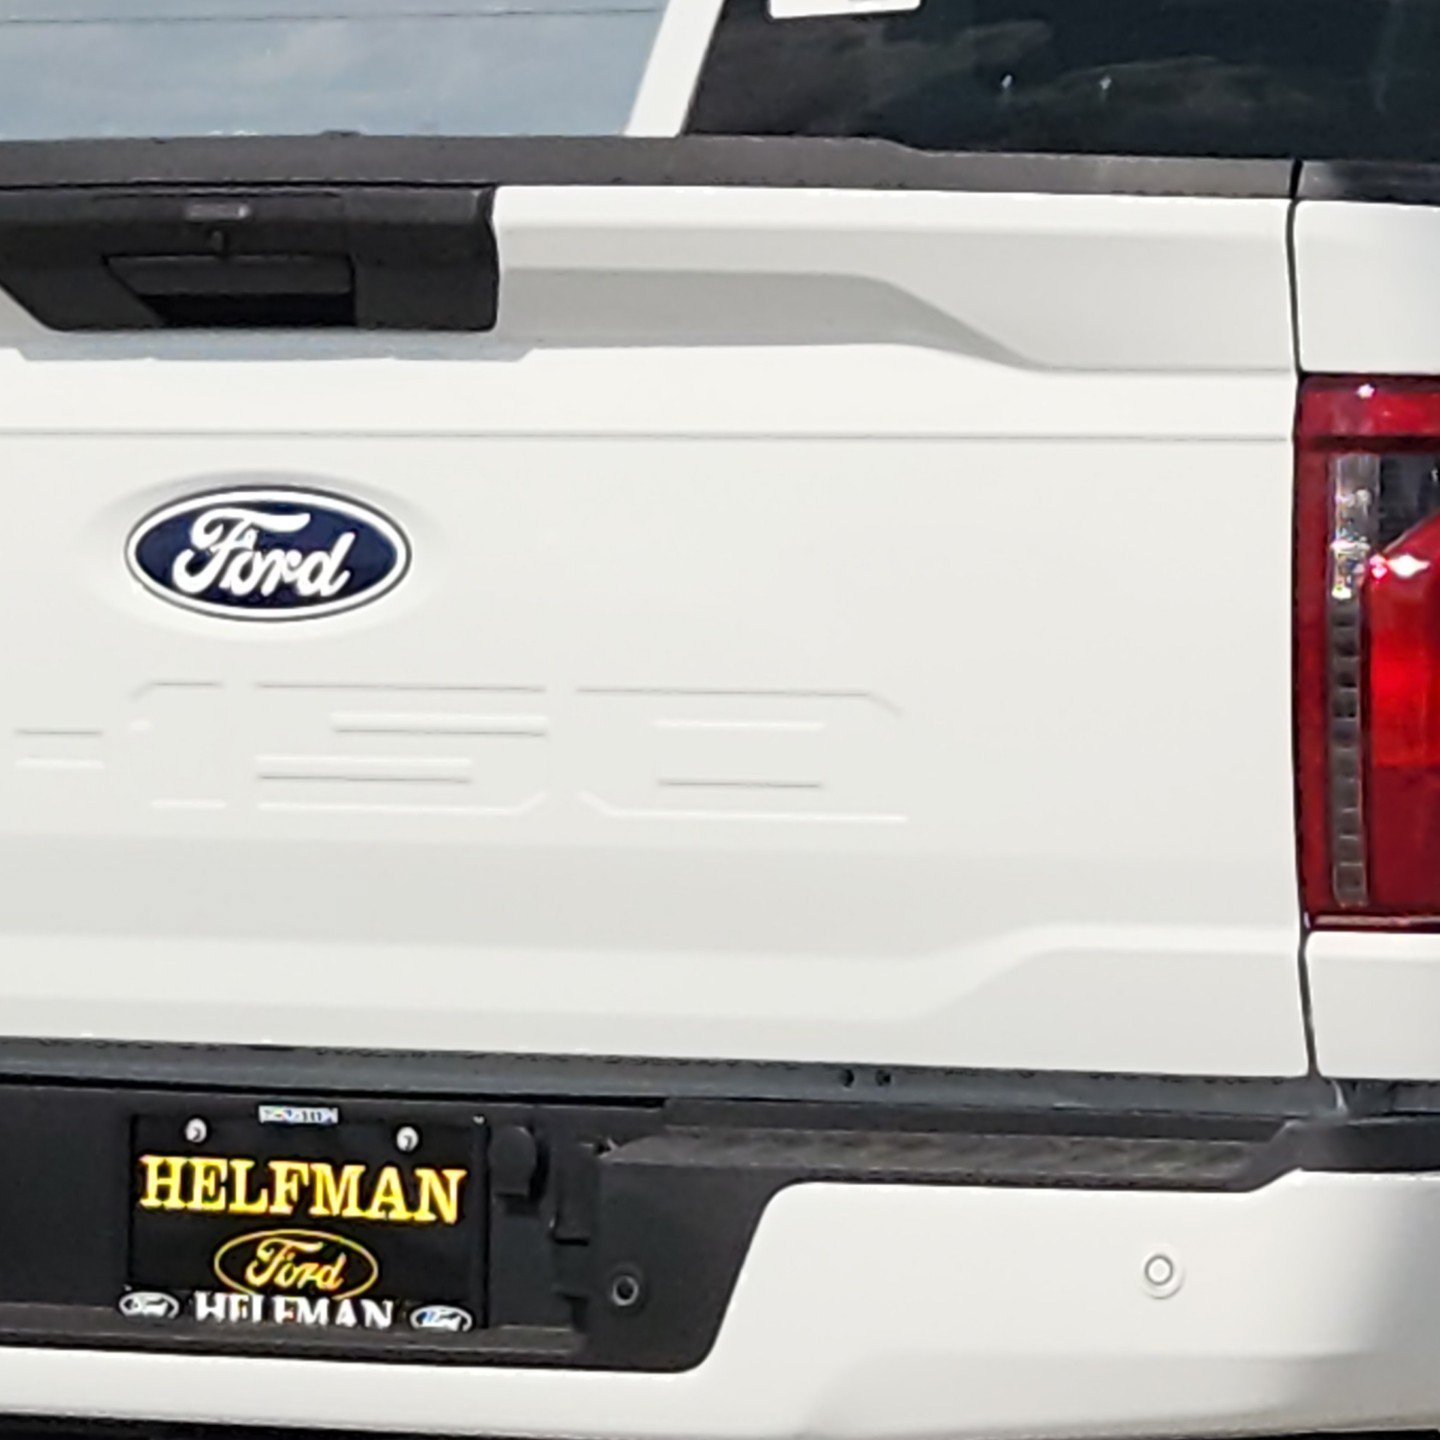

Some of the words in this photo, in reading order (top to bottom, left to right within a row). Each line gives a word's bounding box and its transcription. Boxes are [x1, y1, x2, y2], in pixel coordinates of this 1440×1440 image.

[172, 507, 356, 597] Ford
[138, 1153, 468, 1225] HELFMAN
[244, 1236, 347, 1290] Ford
[192, 1290, 394, 1330] HELFMAN
